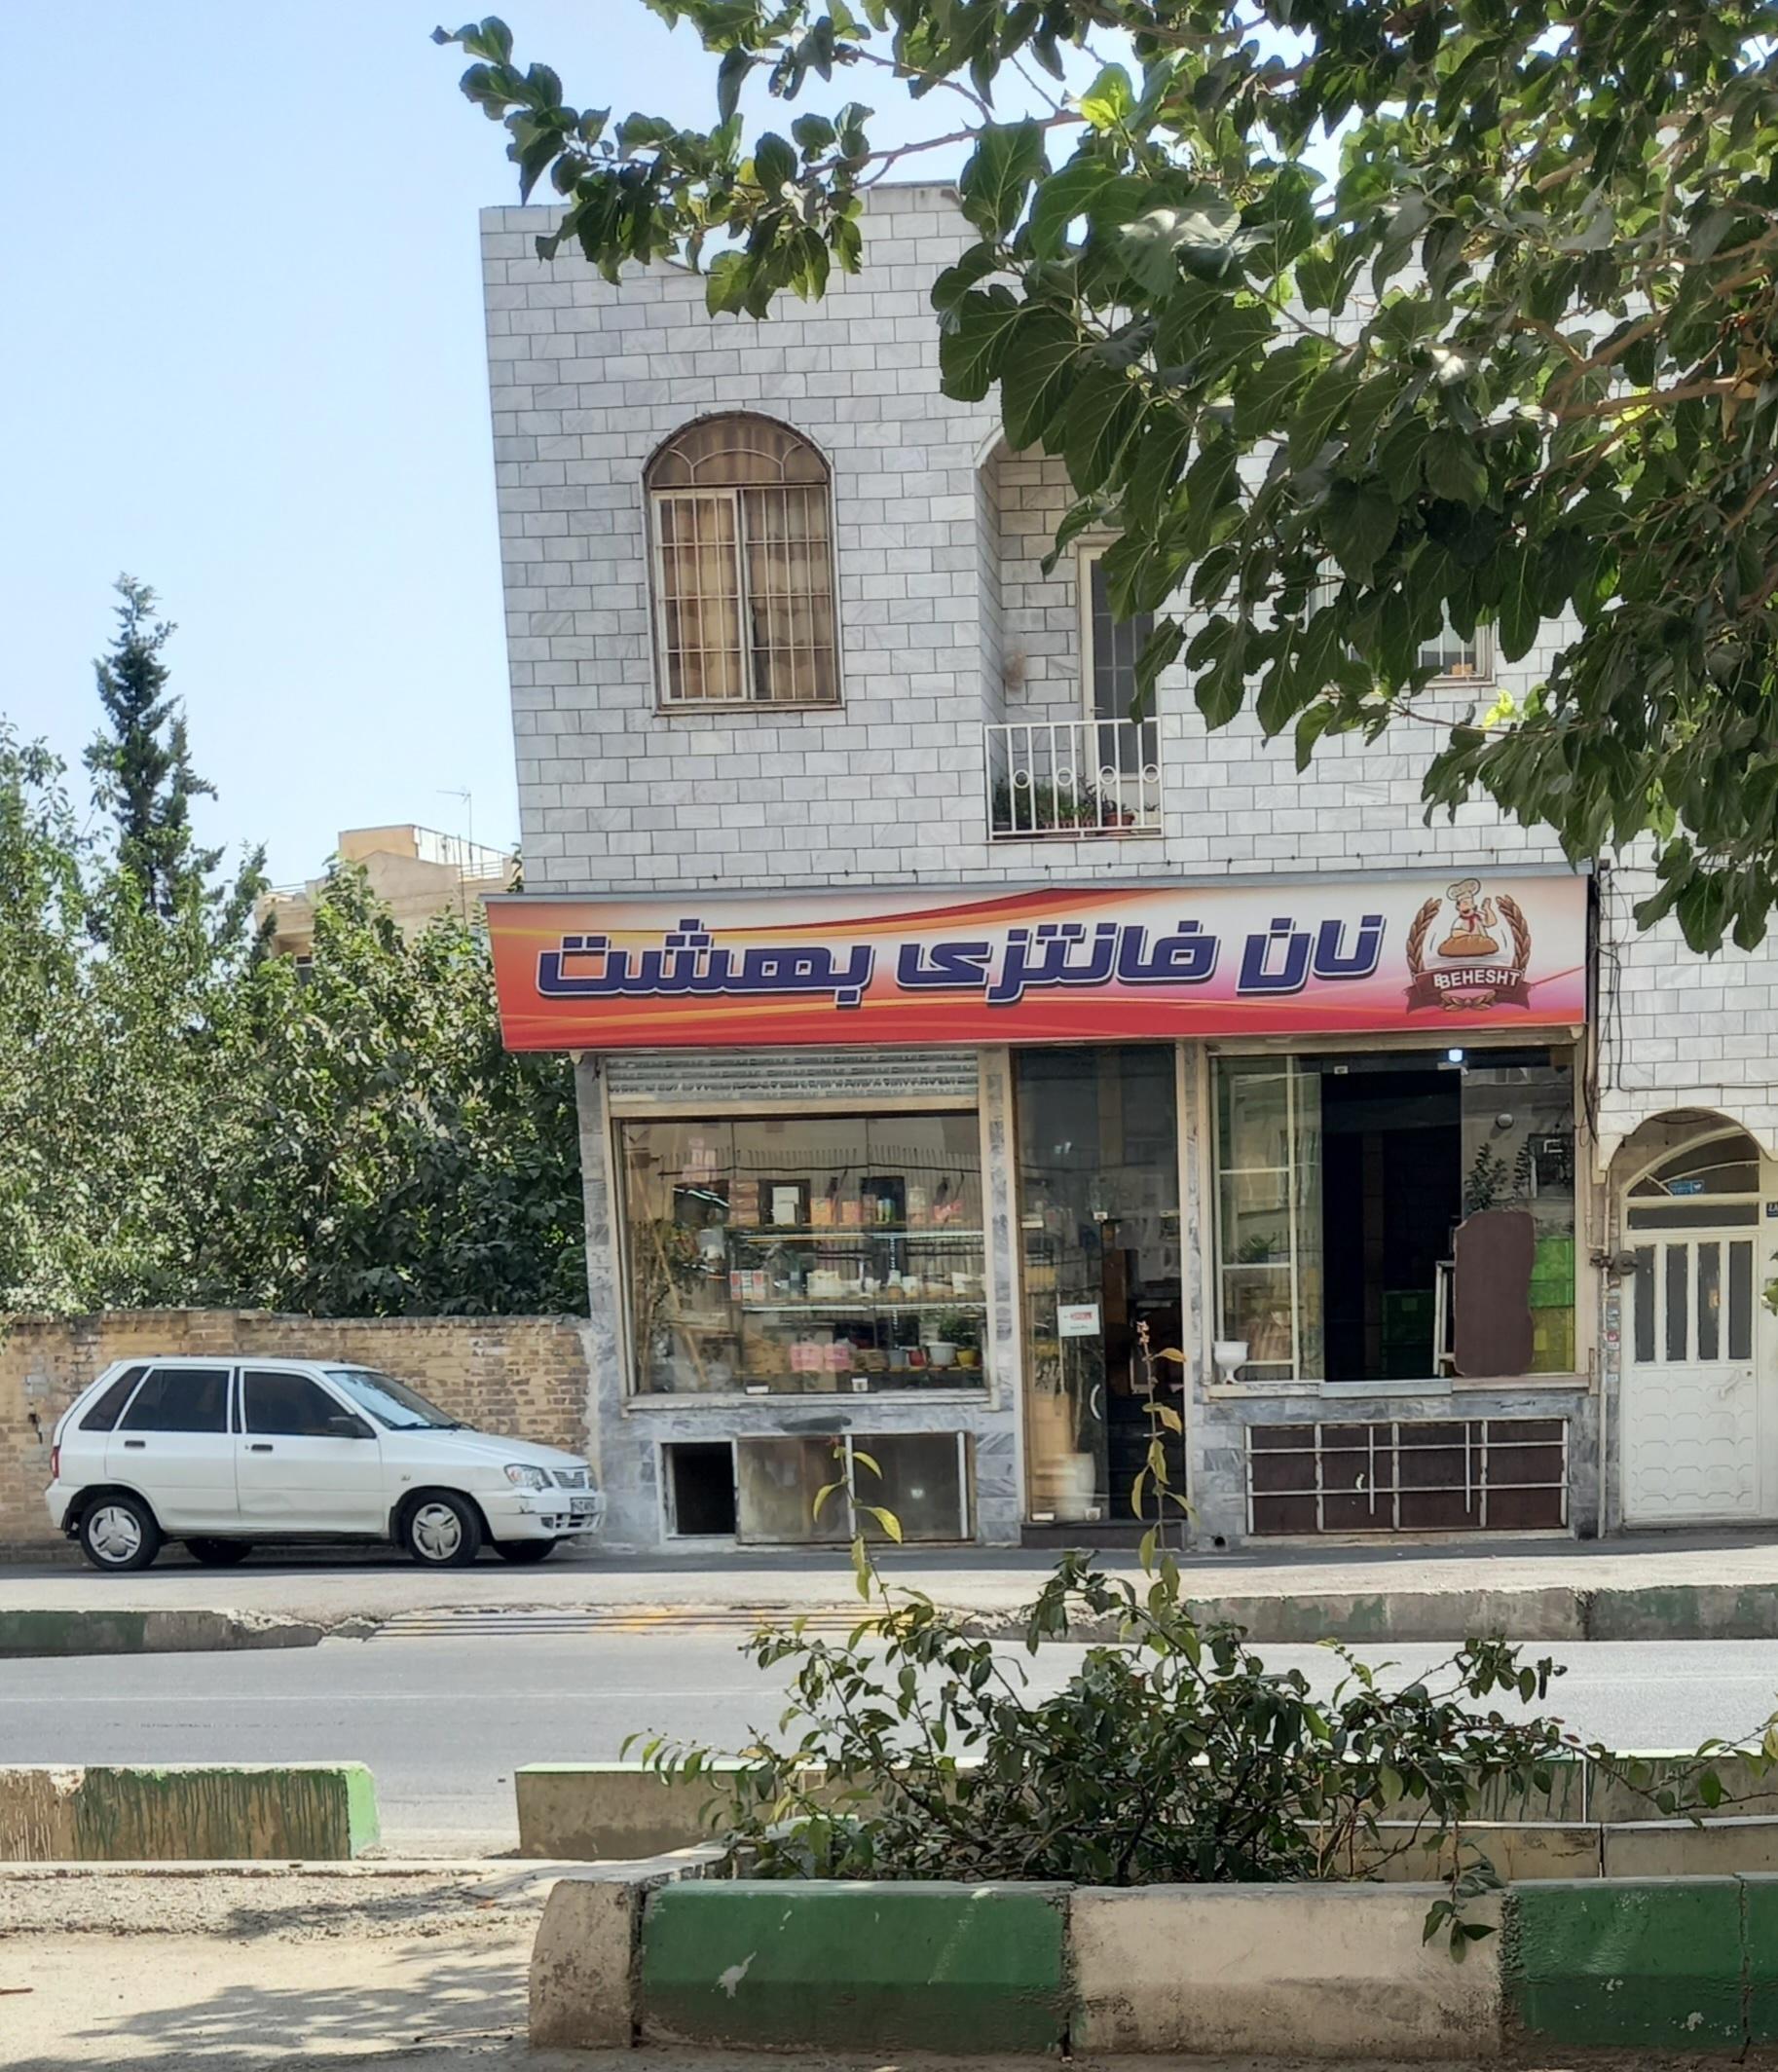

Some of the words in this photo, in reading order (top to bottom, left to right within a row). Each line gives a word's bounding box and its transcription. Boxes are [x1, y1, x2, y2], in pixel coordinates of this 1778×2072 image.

[536, 918, 874, 1008] بهشت
[896, 920, 1219, 1006] فانتزی
[1236, 913, 1385, 996] نان
